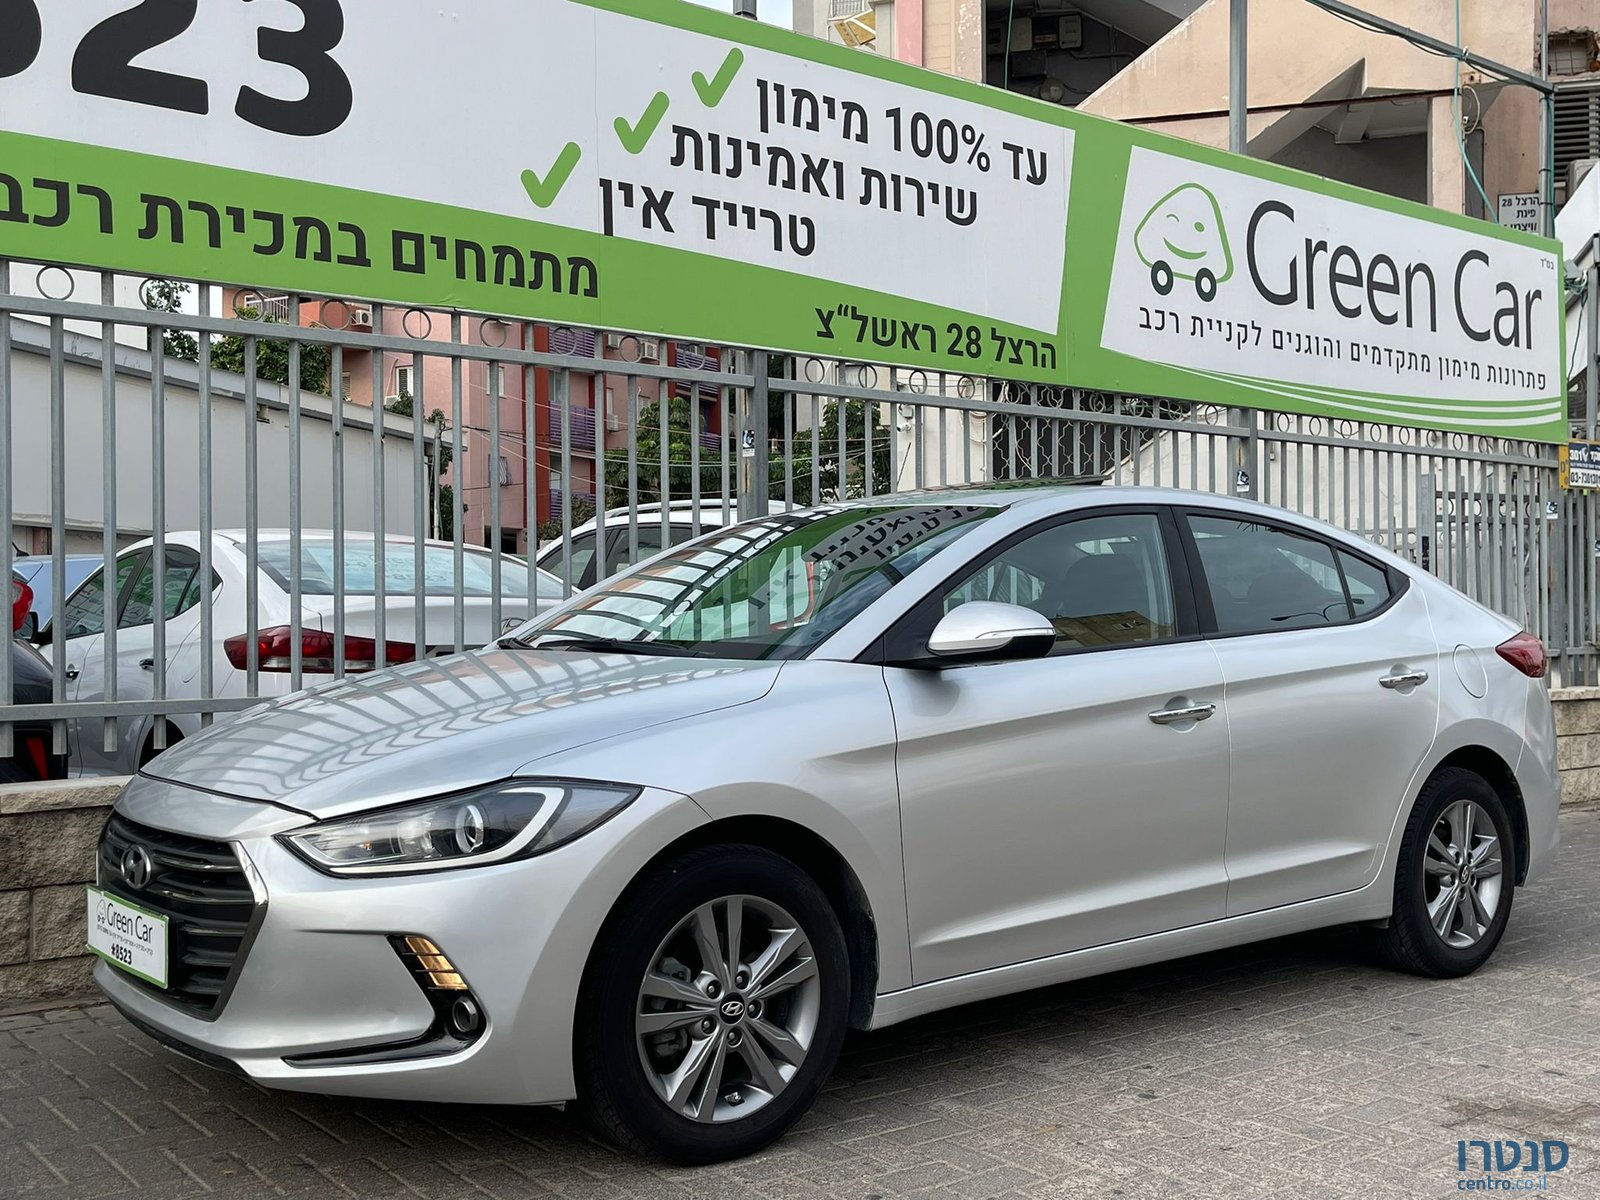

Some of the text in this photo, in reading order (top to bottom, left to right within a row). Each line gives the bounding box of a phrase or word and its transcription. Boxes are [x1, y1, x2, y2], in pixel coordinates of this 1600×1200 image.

[756, 78, 1048, 186] עד 100% מימון
[670, 124, 978, 227] שירות ואמינות
[1501, 198, 1513, 207] 28
[1516, 208, 1536, 218] פינת
[0, 172, 599, 298] מתמחים במכירת רכב
[599, 177, 817, 257] טרייד אין
[1246, 199, 1542, 350] Green Car
[946, 322, 982, 359] 28
[990, 327, 1057, 370] הרצל
[1139, 306, 1546, 391] פתרונות מימון מתקדמים והוגנים לקניית רכב
[107, 903, 134, 936] Green
[135, 915, 153, 943] Car
